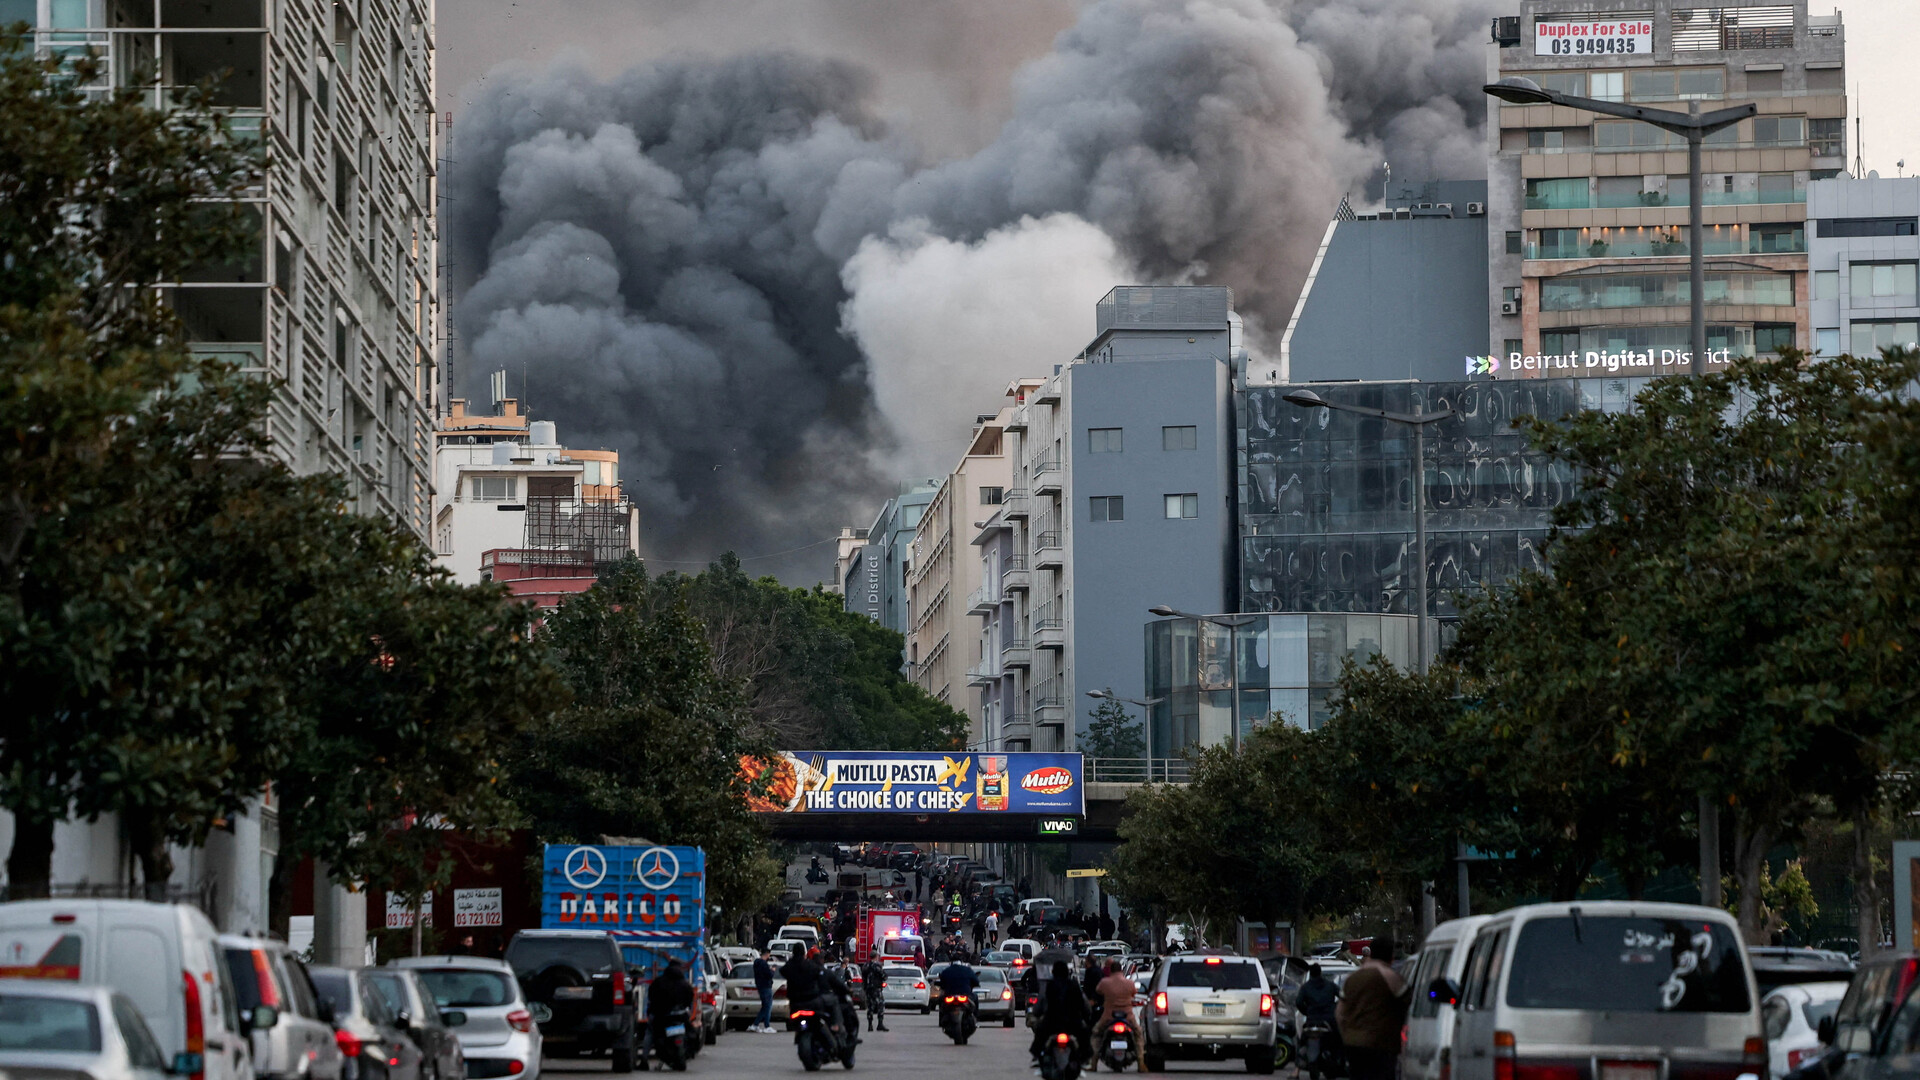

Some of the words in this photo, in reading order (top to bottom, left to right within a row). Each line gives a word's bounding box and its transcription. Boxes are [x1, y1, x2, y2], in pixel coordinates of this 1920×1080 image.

[1539, 23, 1588, 38] Duplex
[1592, 23, 1615, 35] For
[1619, 22, 1650, 35] Sale
[1551, 39, 1571, 54] 03
[1576, 38, 1635, 54] 949435
[1510, 350, 1579, 370] Beirut
[1585, 348, 1654, 372] Digital
[1661, 347, 1731, 366] Disict
[868, 555, 879, 603] District
[837, 764, 887, 781] MUTLU
[891, 764, 937, 781] PASTA
[1021, 771, 1070, 788] Mutlu
[805, 790, 835, 809] THE
[837, 790, 892, 809] CHOICE
[895, 790, 914, 809] OF
[918, 790, 964, 809] CHEFS
[1043, 820, 1073, 831] VIVAD
[559, 891, 681, 925] DARICO
[388, 913, 398, 926] 03
[400, 913, 415, 926] 723
[456, 912, 466, 925] 03
[469, 912, 483, 925] 723
[486, 911, 500, 924] 022
